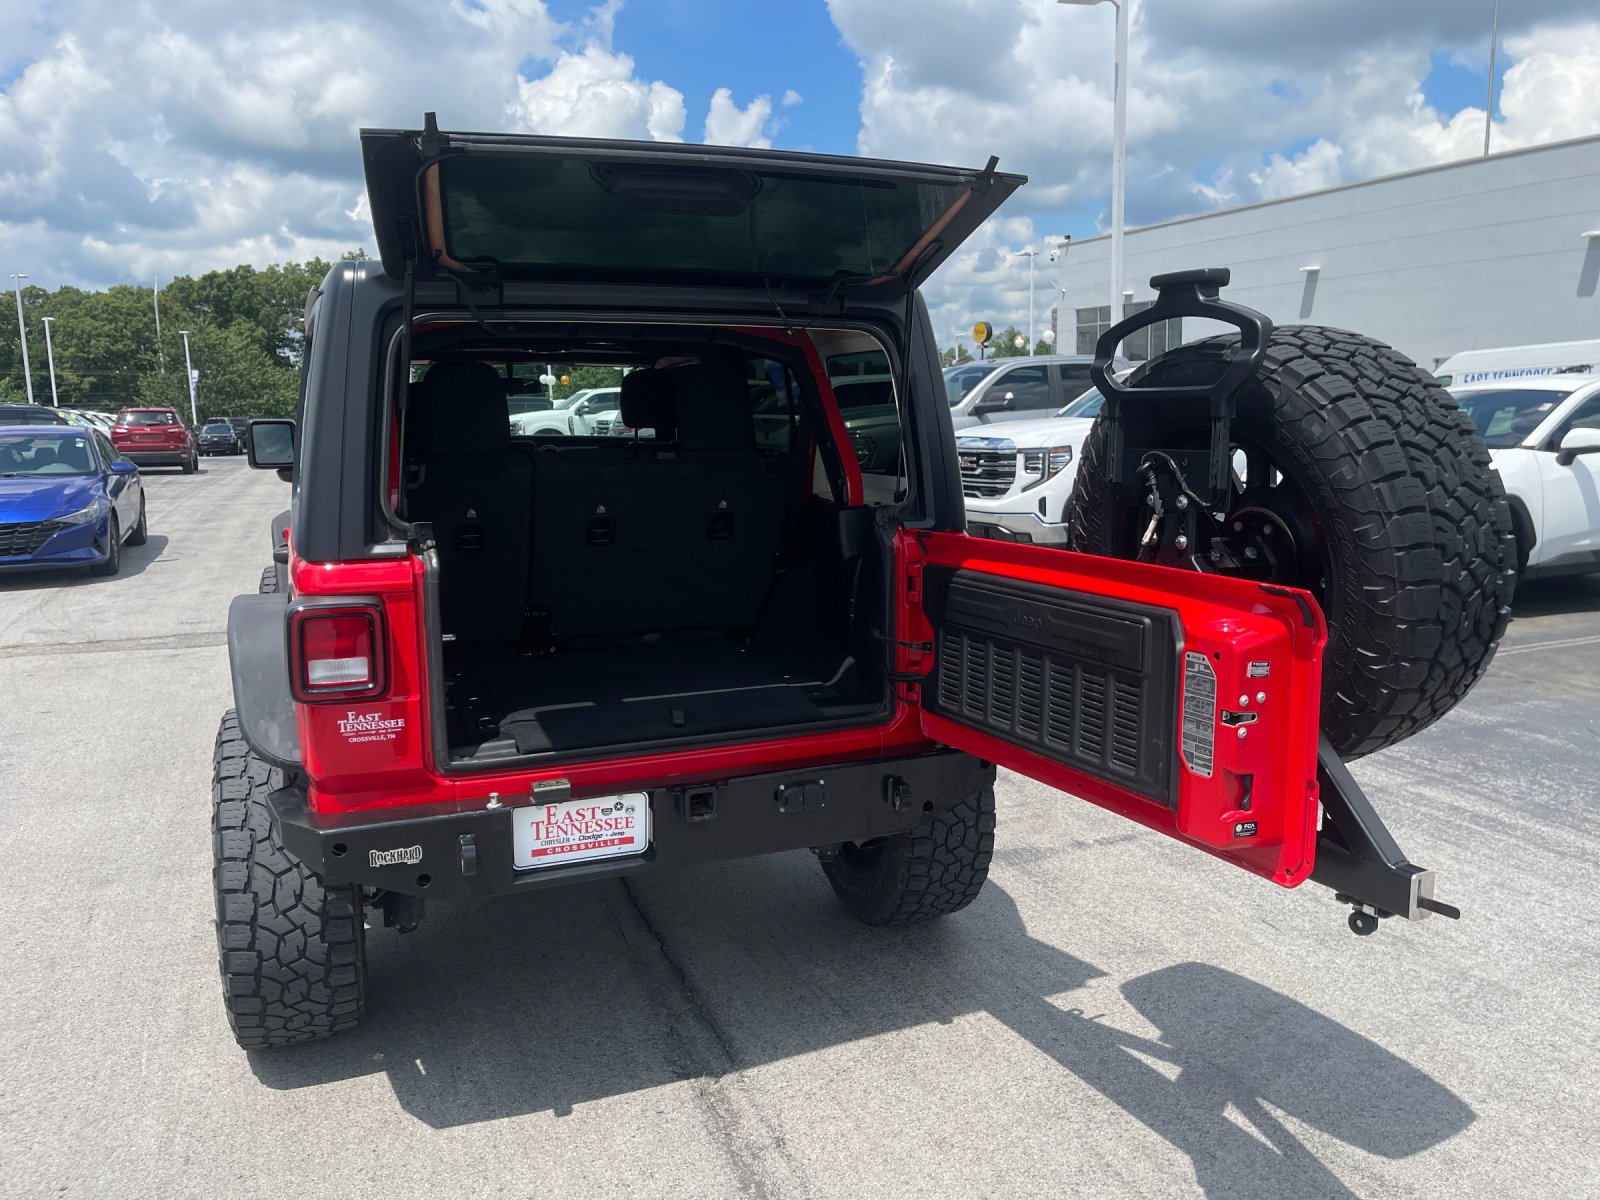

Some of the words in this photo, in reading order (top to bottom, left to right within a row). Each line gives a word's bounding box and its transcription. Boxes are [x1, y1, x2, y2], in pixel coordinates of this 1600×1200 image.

[337, 718, 406, 733] TENNESSEE
[346, 711, 382, 724] EAST
[348, 734, 387, 743] CROSSVILLE,
[545, 805, 601, 827] EAST
[530, 816, 635, 841] TENNESSEE
[540, 837, 570, 847] CHRYSLER
[578, 833, 604, 842] Dodge
[610, 830, 625, 838] Jeep
[546, 839, 621, 854] CROSSVILLE
[368, 845, 422, 867] ROCKHARD
